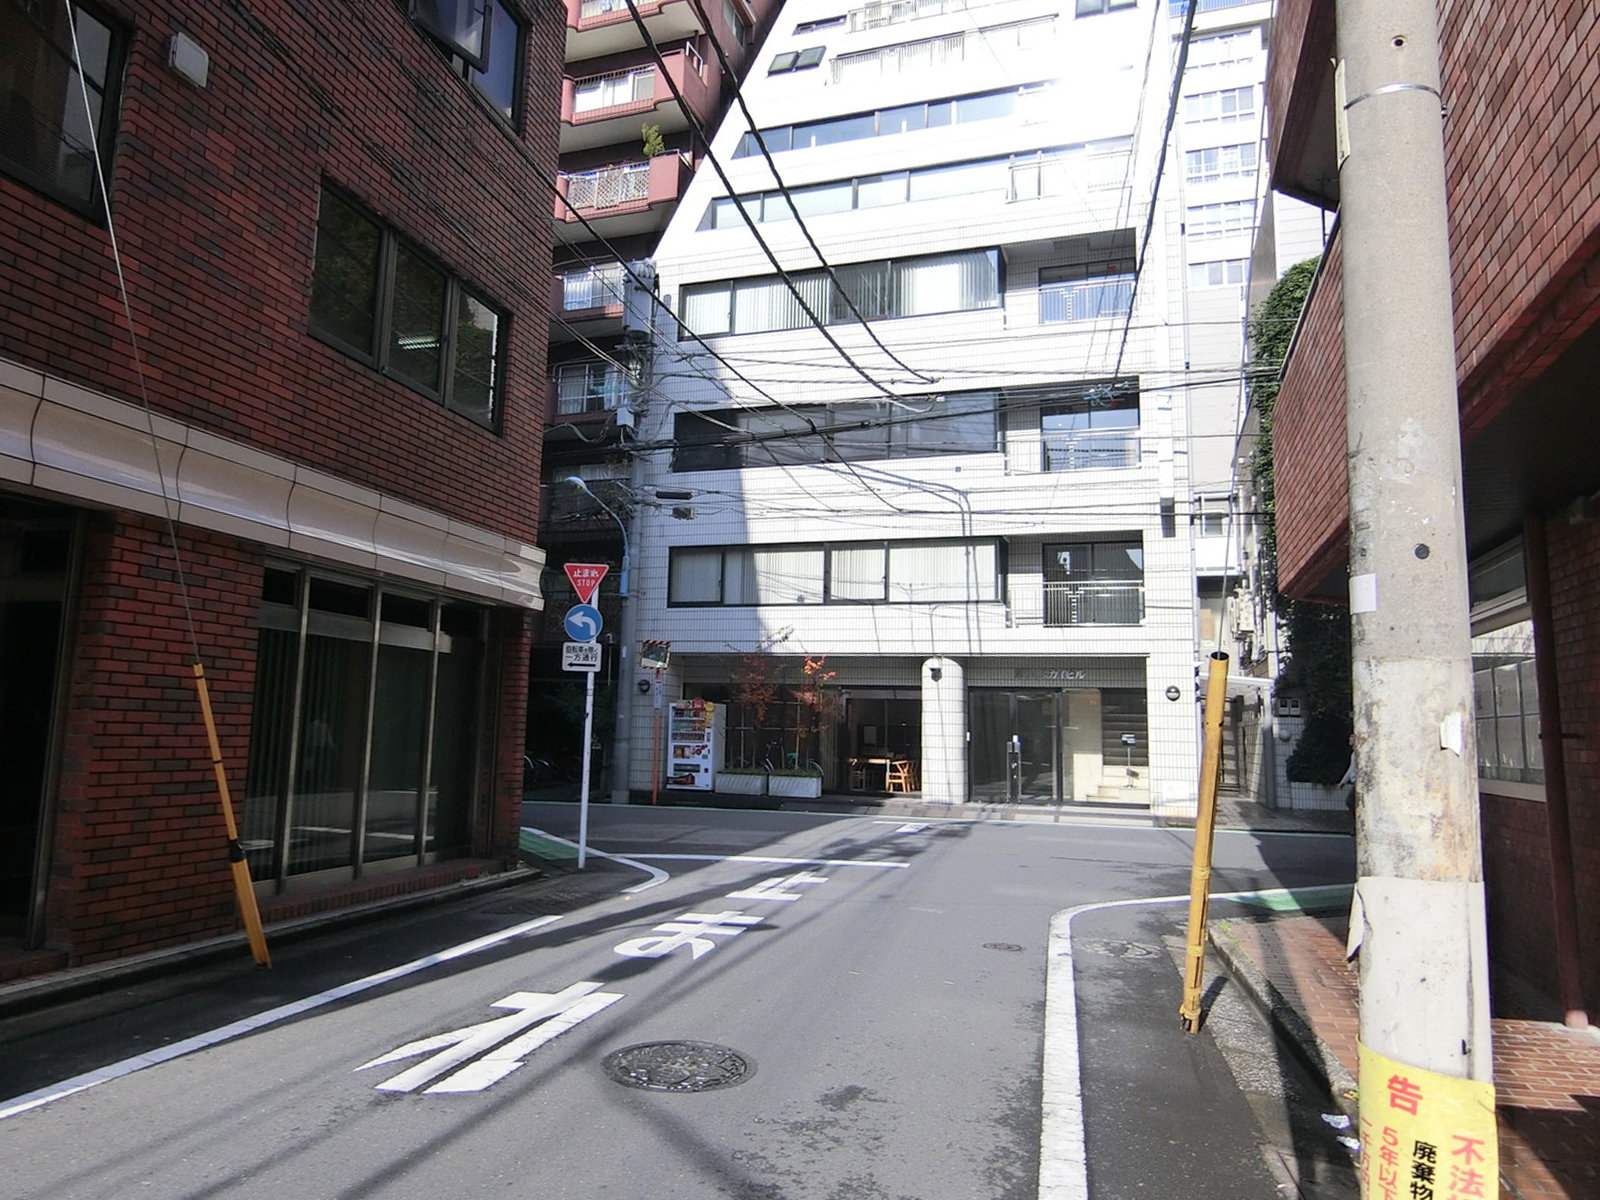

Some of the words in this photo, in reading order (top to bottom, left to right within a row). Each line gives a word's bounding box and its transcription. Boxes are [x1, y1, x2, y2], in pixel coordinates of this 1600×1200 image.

[573, 568, 599, 578] 止まれ
[576, 579, 596, 587] STOP
[565, 653, 598, 662] 一方通行
[353, 871, 829, 1095] 止まれ
[1387, 1074, 1423, 1116] 告
[1446, 1134, 1486, 1200] 不法
